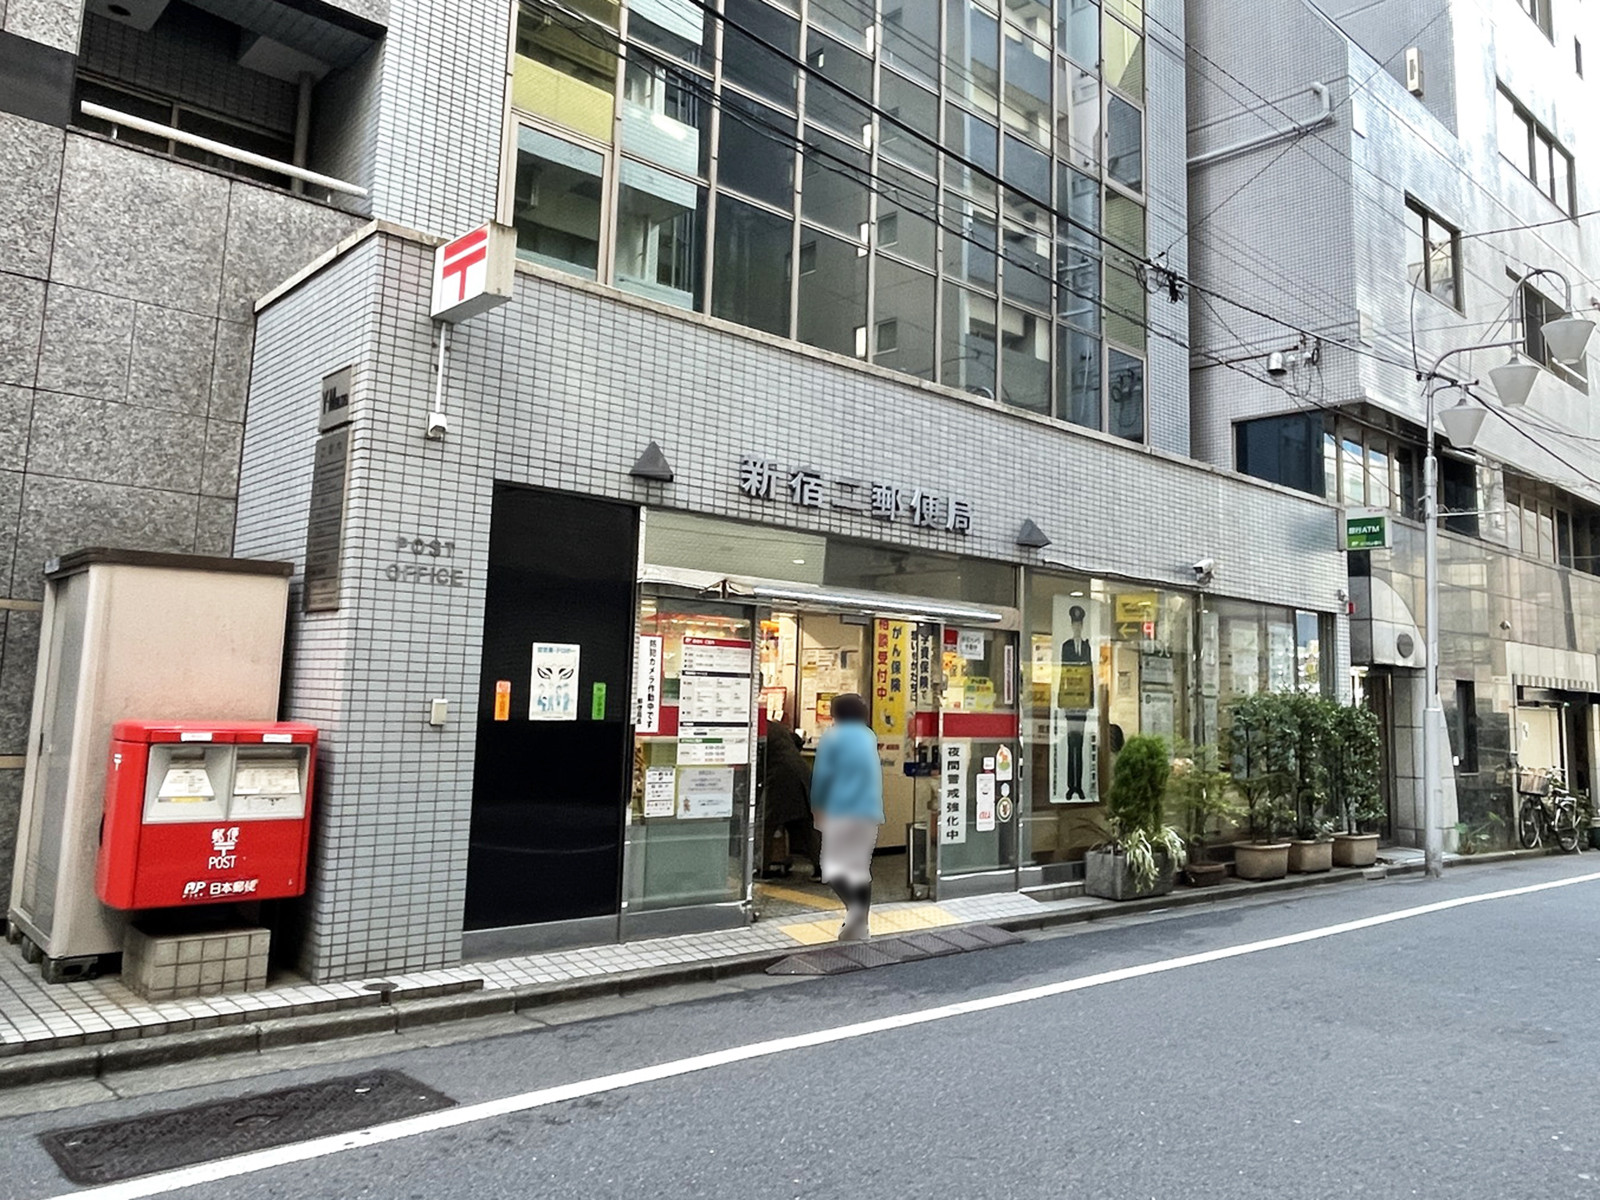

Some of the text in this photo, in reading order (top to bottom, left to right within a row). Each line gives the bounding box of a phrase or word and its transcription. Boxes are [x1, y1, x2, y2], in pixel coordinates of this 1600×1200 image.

[740, 454, 974, 535] 新宿二郵便局
[384, 564, 464, 587] OFFICE
[395, 536, 455, 558] POST
[646, 639, 657, 729] 防犯カメラ作動中です
[891, 626, 902, 693] がん保険
[946, 747, 960, 840] 夜間警戒強化中
[208, 855, 237, 870] POST
